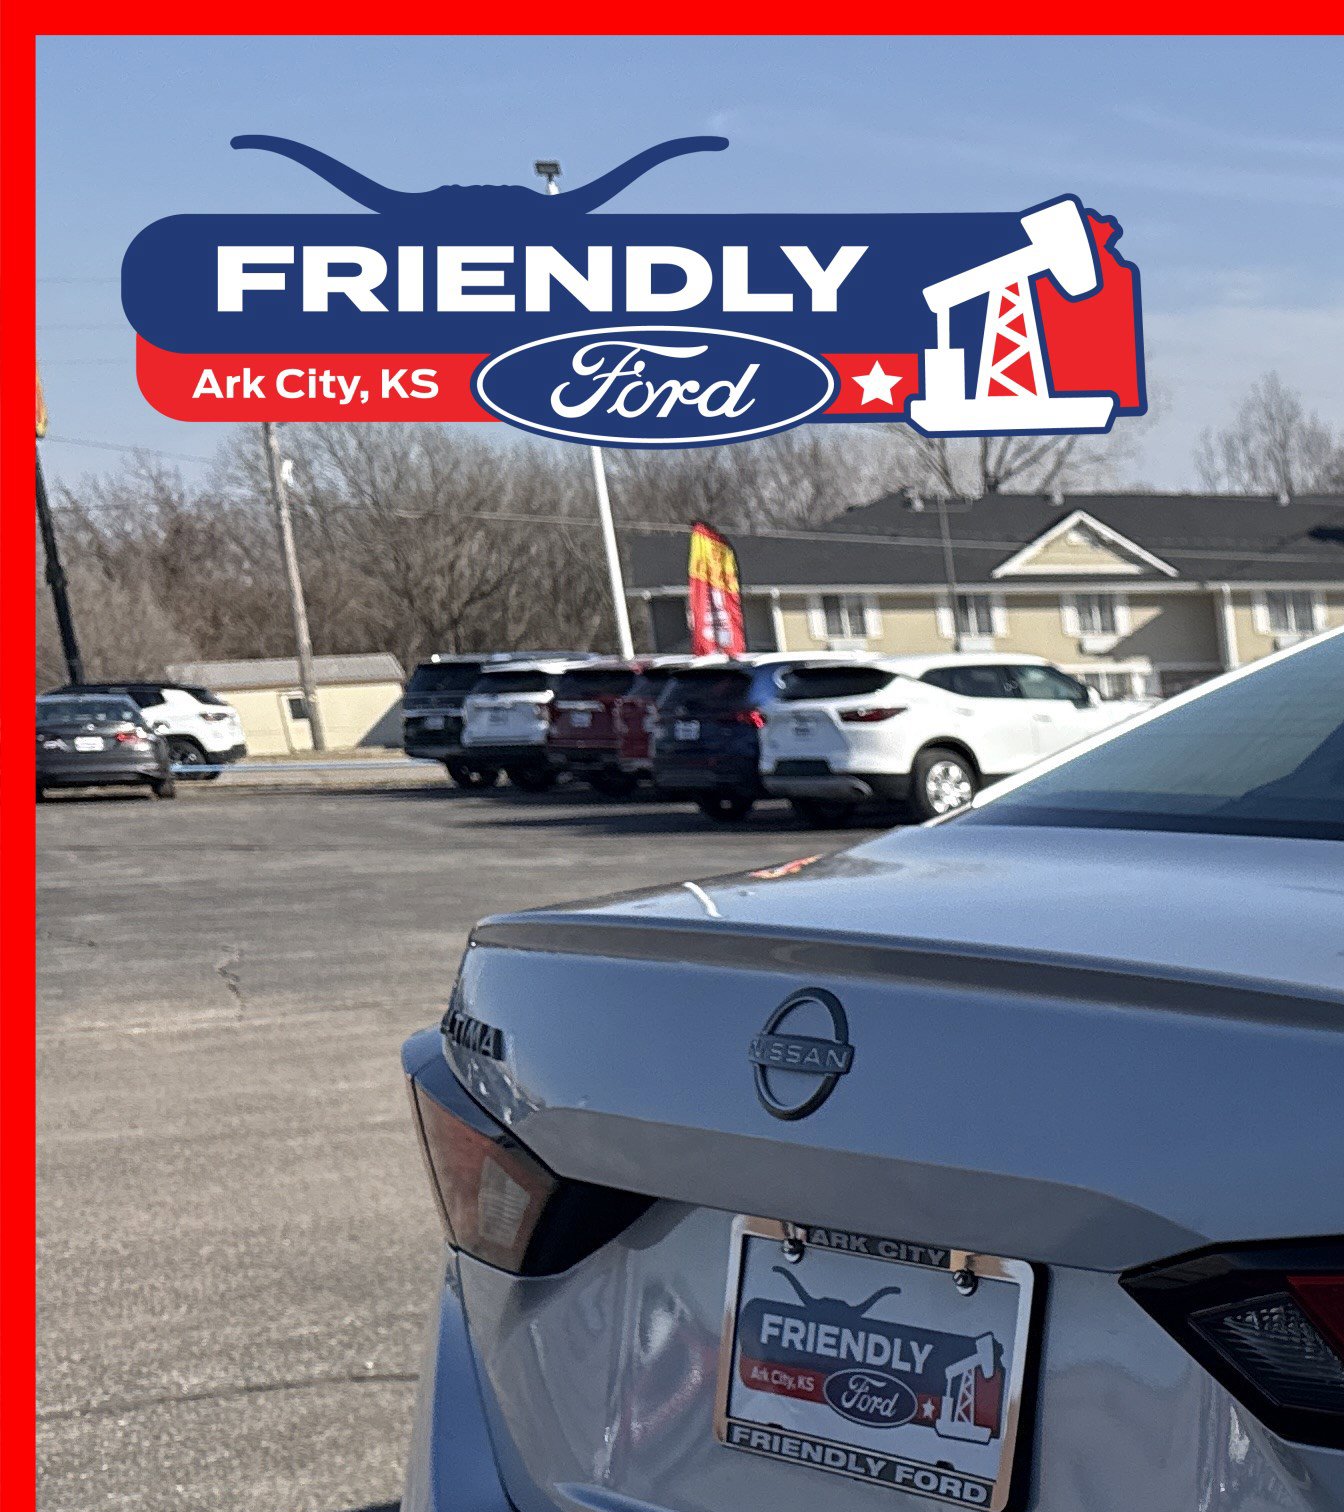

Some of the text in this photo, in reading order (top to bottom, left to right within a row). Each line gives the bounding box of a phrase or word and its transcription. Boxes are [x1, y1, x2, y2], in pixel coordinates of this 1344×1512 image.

[808, 1226, 946, 1267] ARK CITY
[759, 1312, 934, 1375] FRIENDLY
[750, 1365, 769, 1384] Ark
[797, 1374, 816, 1393] KS
[841, 1373, 899, 1418] Ford
[731, 1426, 988, 1504] FRIENDLY FORD
